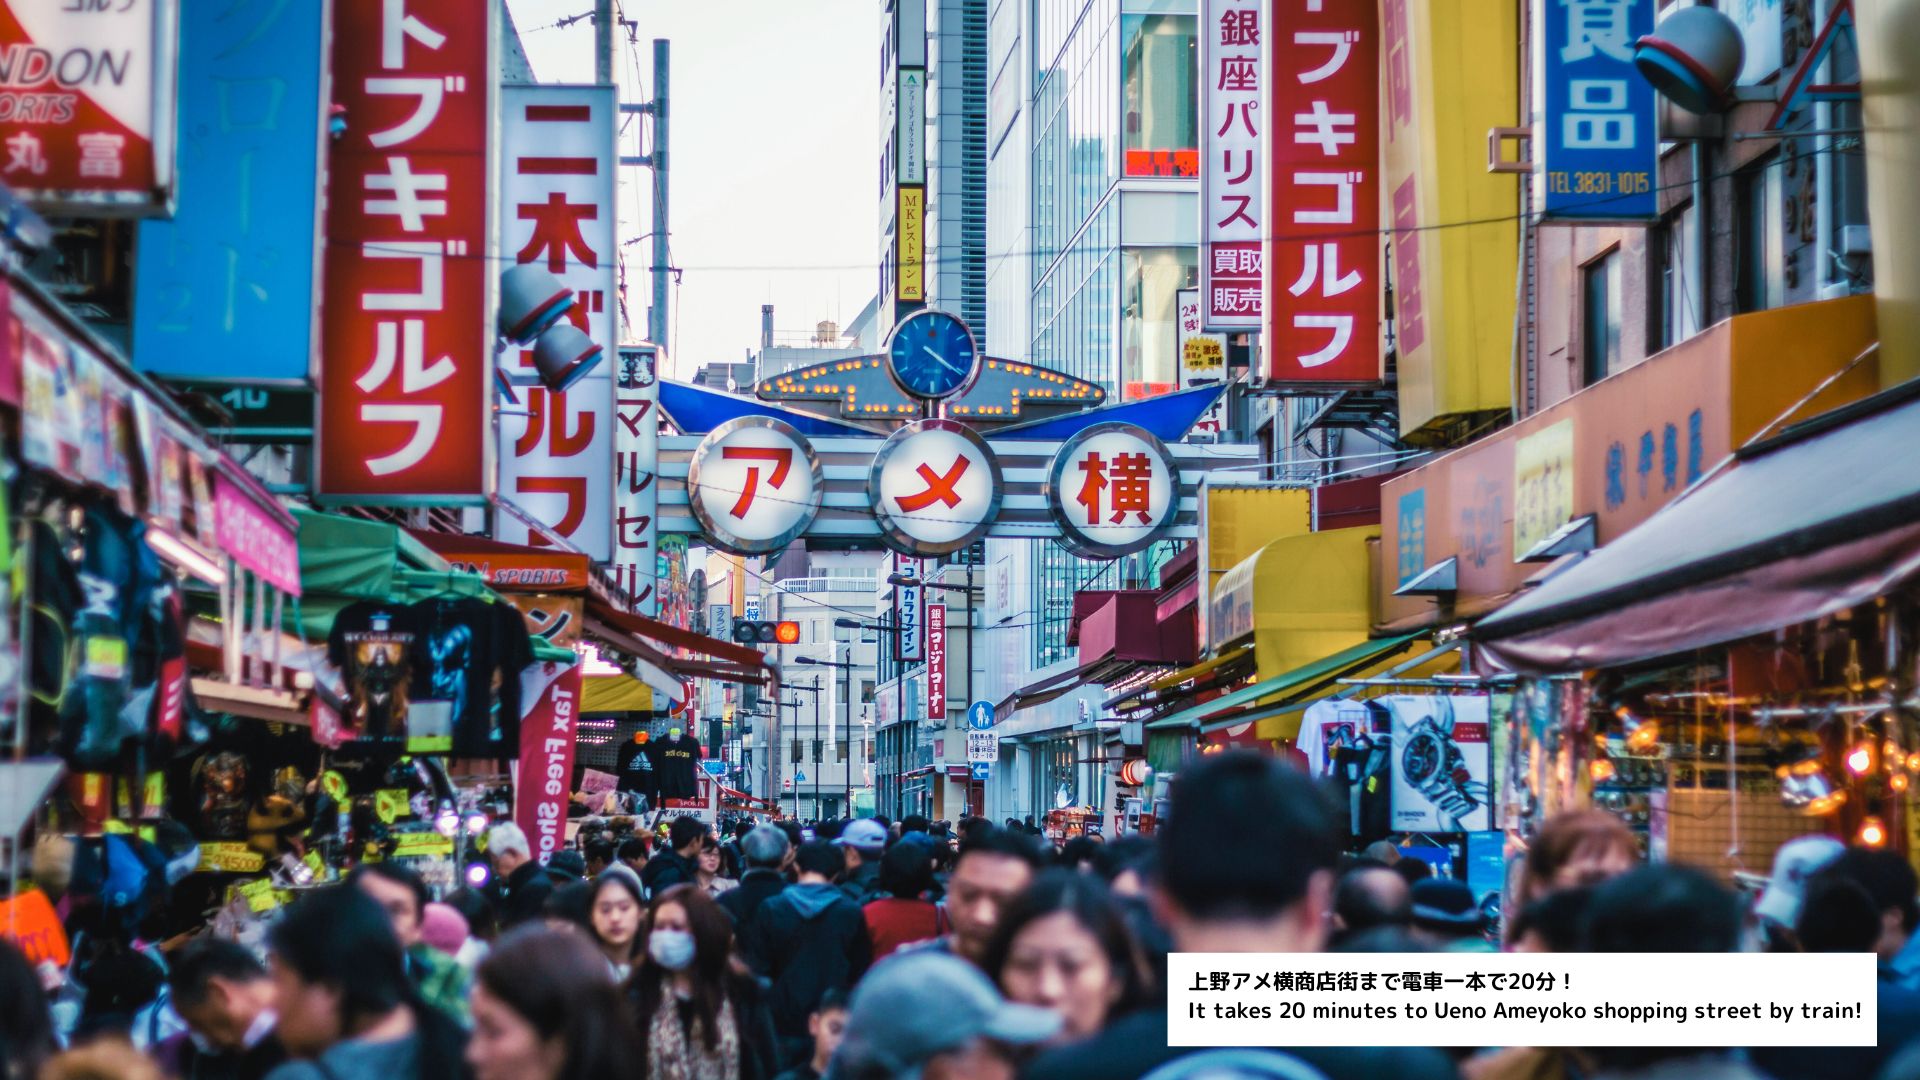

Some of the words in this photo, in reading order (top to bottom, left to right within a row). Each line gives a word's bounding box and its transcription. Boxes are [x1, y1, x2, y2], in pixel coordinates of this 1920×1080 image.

[1559, 0, 1639, 149] 食品
[1217, 9, 1261, 229] 銀座パリス
[1288, 0, 1363, 368] ブキゴルフ
[1549, 172, 1571, 193] TEL
[1574, 172, 1650, 193] 3831-1015
[905, 195, 918, 279] MKレストラン
[1214, 249, 1262, 274] 買取
[515, 105, 604, 547] 二木ルフ
[1214, 287, 1262, 313] 販売
[722, 446, 1153, 525] アメ横
[494, 568, 567, 585] SPORTS
